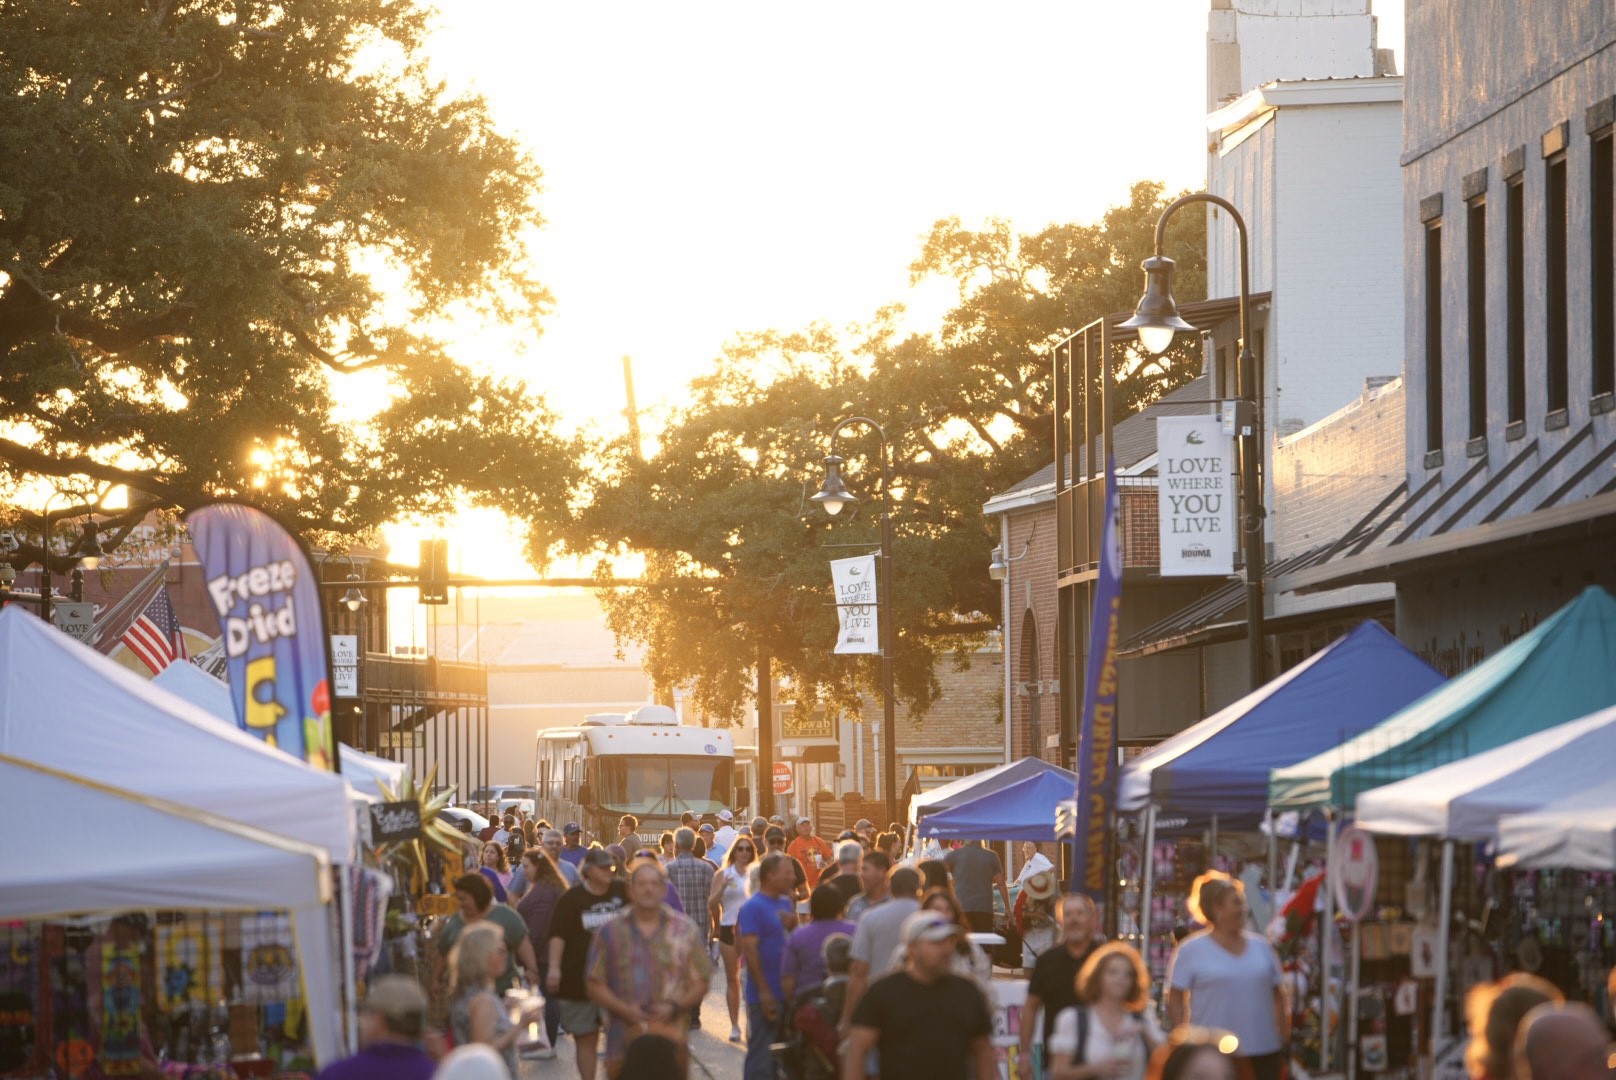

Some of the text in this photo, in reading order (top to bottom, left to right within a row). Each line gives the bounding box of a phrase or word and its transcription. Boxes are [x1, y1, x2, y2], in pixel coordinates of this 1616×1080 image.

[1168, 457, 1222, 474] LOVE
[1167, 477, 1223, 490] WHERE
[1168, 494, 1222, 514] YOU
[1171, 517, 1221, 533] LIVE
[1181, 549, 1212, 558] HOUMA
[840, 581, 871, 596] LOVE
[843, 605, 871, 619] YOU
[60, 624, 89, 633] LOVE
[844, 618, 871, 631] LIVE
[333, 650, 354, 658] LOVE
[333, 665, 353, 673] YOU
[334, 673, 353, 681] LIVE
